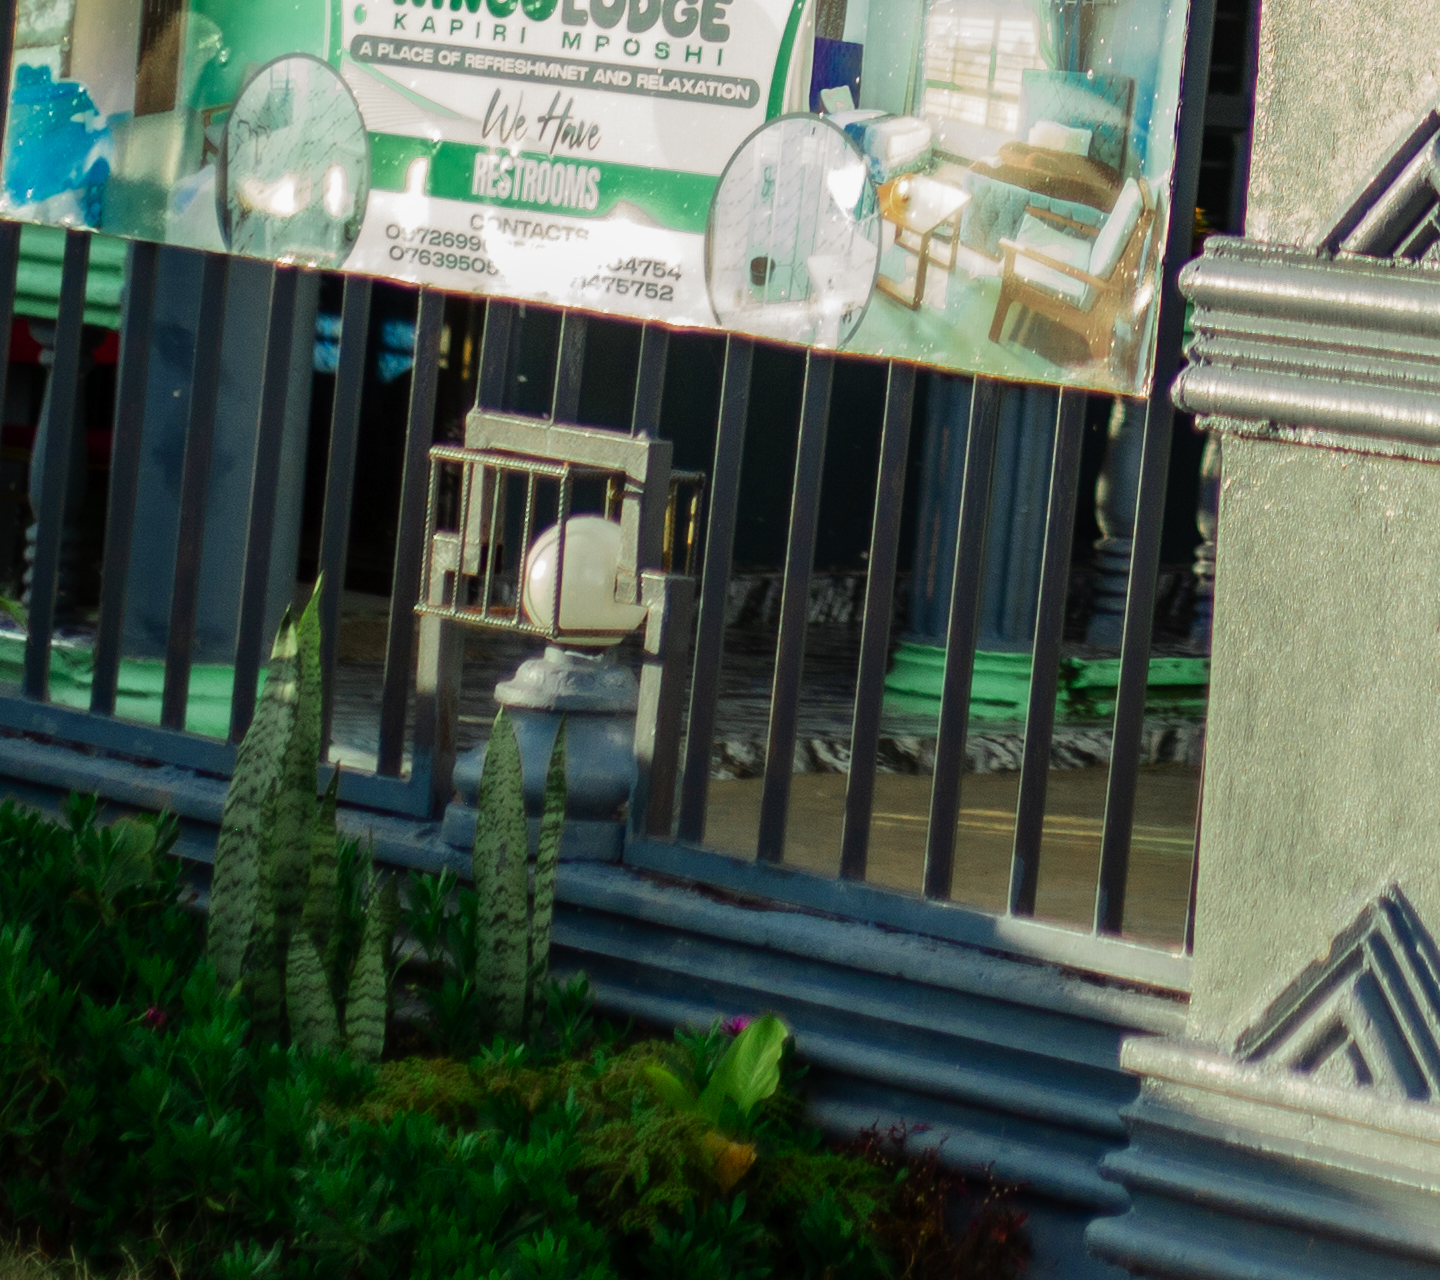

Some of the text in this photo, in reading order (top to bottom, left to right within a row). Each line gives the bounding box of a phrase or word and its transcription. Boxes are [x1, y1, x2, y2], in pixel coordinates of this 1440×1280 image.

[394, 13, 724, 67] KAPIRI MPOSHI
[359, 40, 751, 102] A PLACE OF REFRESHMNET AND RELAXATION
[481, 87, 602, 158] We Have
[471, 152, 601, 211] RESTROOMS
